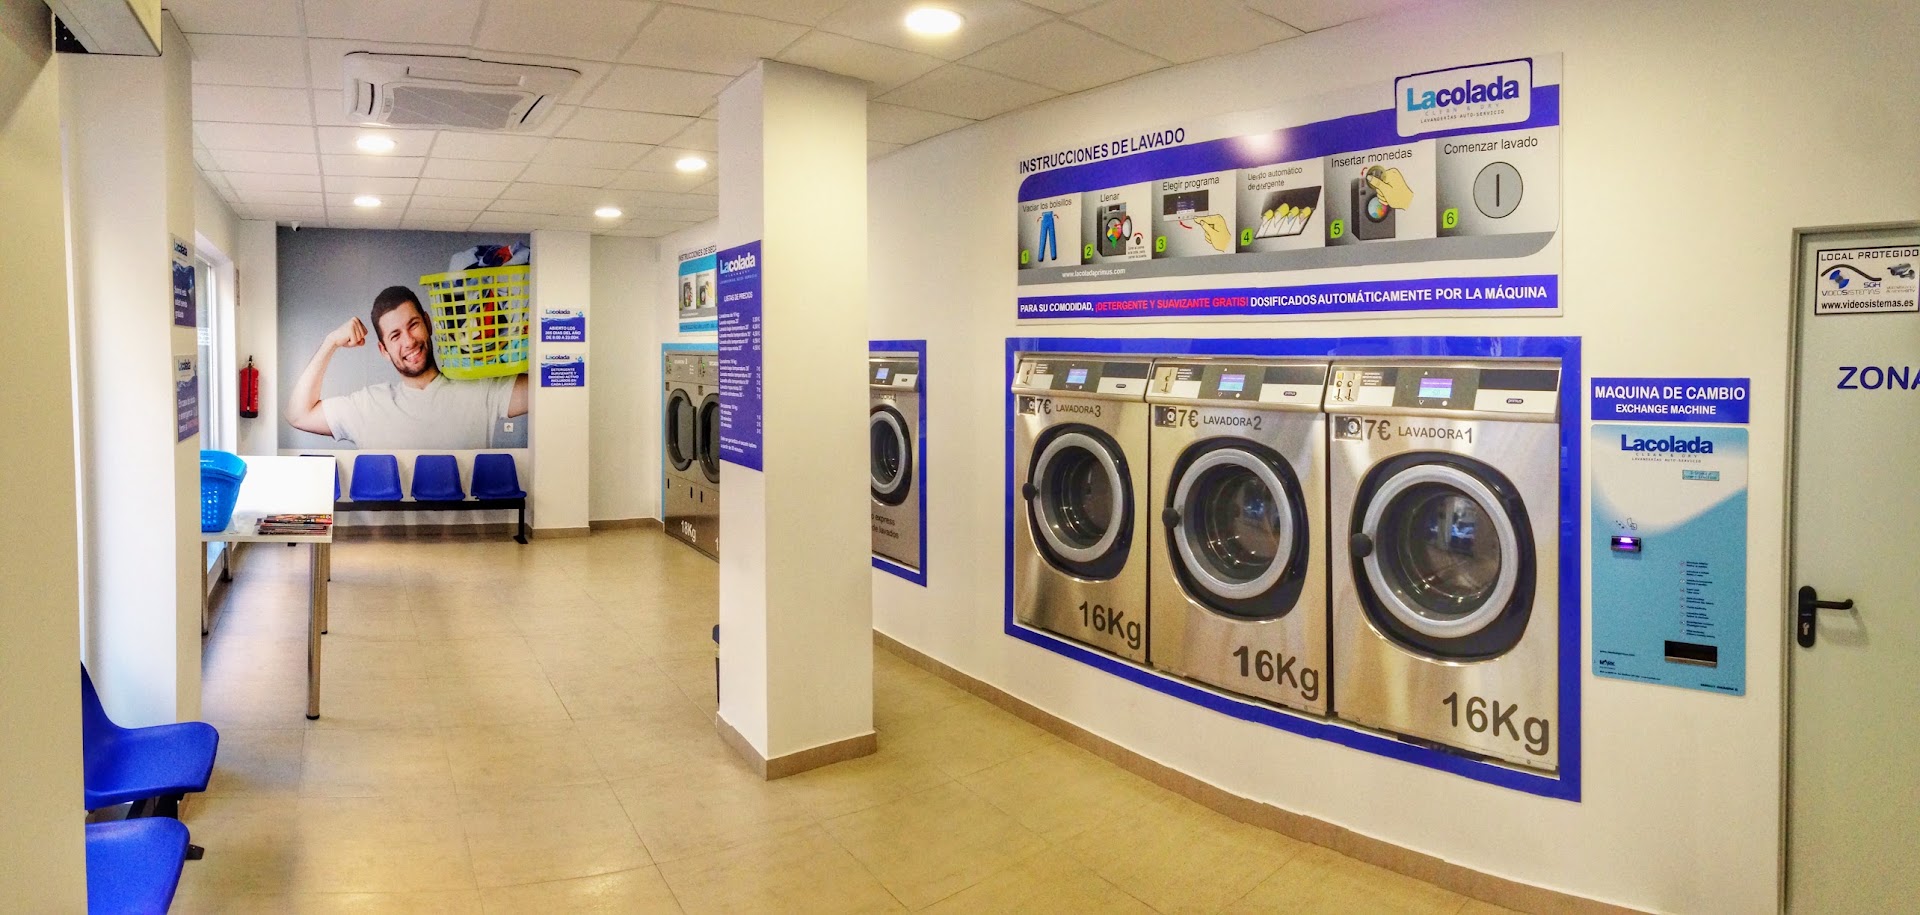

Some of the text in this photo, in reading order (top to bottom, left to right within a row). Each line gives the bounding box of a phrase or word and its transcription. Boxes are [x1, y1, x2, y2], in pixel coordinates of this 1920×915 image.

[1406, 76, 1520, 112] Lacolada
[1020, 128, 1184, 174] INSTRUCCIONES DE LAVADO
[1444, 136, 1538, 154] Comenzar lavado
[1331, 148, 1412, 168] Insertar monedas
[1162, 176, 1220, 192] Elegir programa
[1100, 192, 1120, 202] Llenar
[1446, 212, 1454, 225] 6
[1244, 232, 1250, 242] 4
[1334, 224, 1340, 235] 5
[1086, 246, 1092, 256] 2
[1158, 238, 1164, 250] 3
[720, 252, 755, 274] Lacolada
[1821, 250, 1919, 261] LOCAL PROTEGIDO
[1020, 304, 1038, 313] PARA
[1039, 303, 1048, 312] SU
[1050, 302, 1094, 312] COMODIDAD,
[1149, 300, 1156, 309] Y
[1157, 298, 1210, 309] SUAVIZANTE
[1212, 297, 1248, 308] GRATIS!
[1250, 294, 1317, 307] DOSIFICADOS
[1318, 288, 1432, 304] AUTOMÁTICAMENTE
[1436, 288, 1462, 300] POR
[1466, 287, 1482, 299] LA
[1484, 284, 1547, 300] MÁQUINA
[1821, 299, 1914, 310] www.videosistemas.es
[1595, 386, 1746, 400] MAQUINA DE CAMBIO
[1037, 398, 1051, 415] 7€
[1616, 404, 1716, 415] EXCHANGE MACHINE
[1178, 410, 1198, 427] 7€
[1365, 420, 1391, 440] 7€
[1621, 434, 1713, 454] Lacolada
[1078, 600, 1141, 650] 16Kg
[1233, 646, 1320, 701] 16Kg
[1442, 692, 1550, 756] 16Kg
